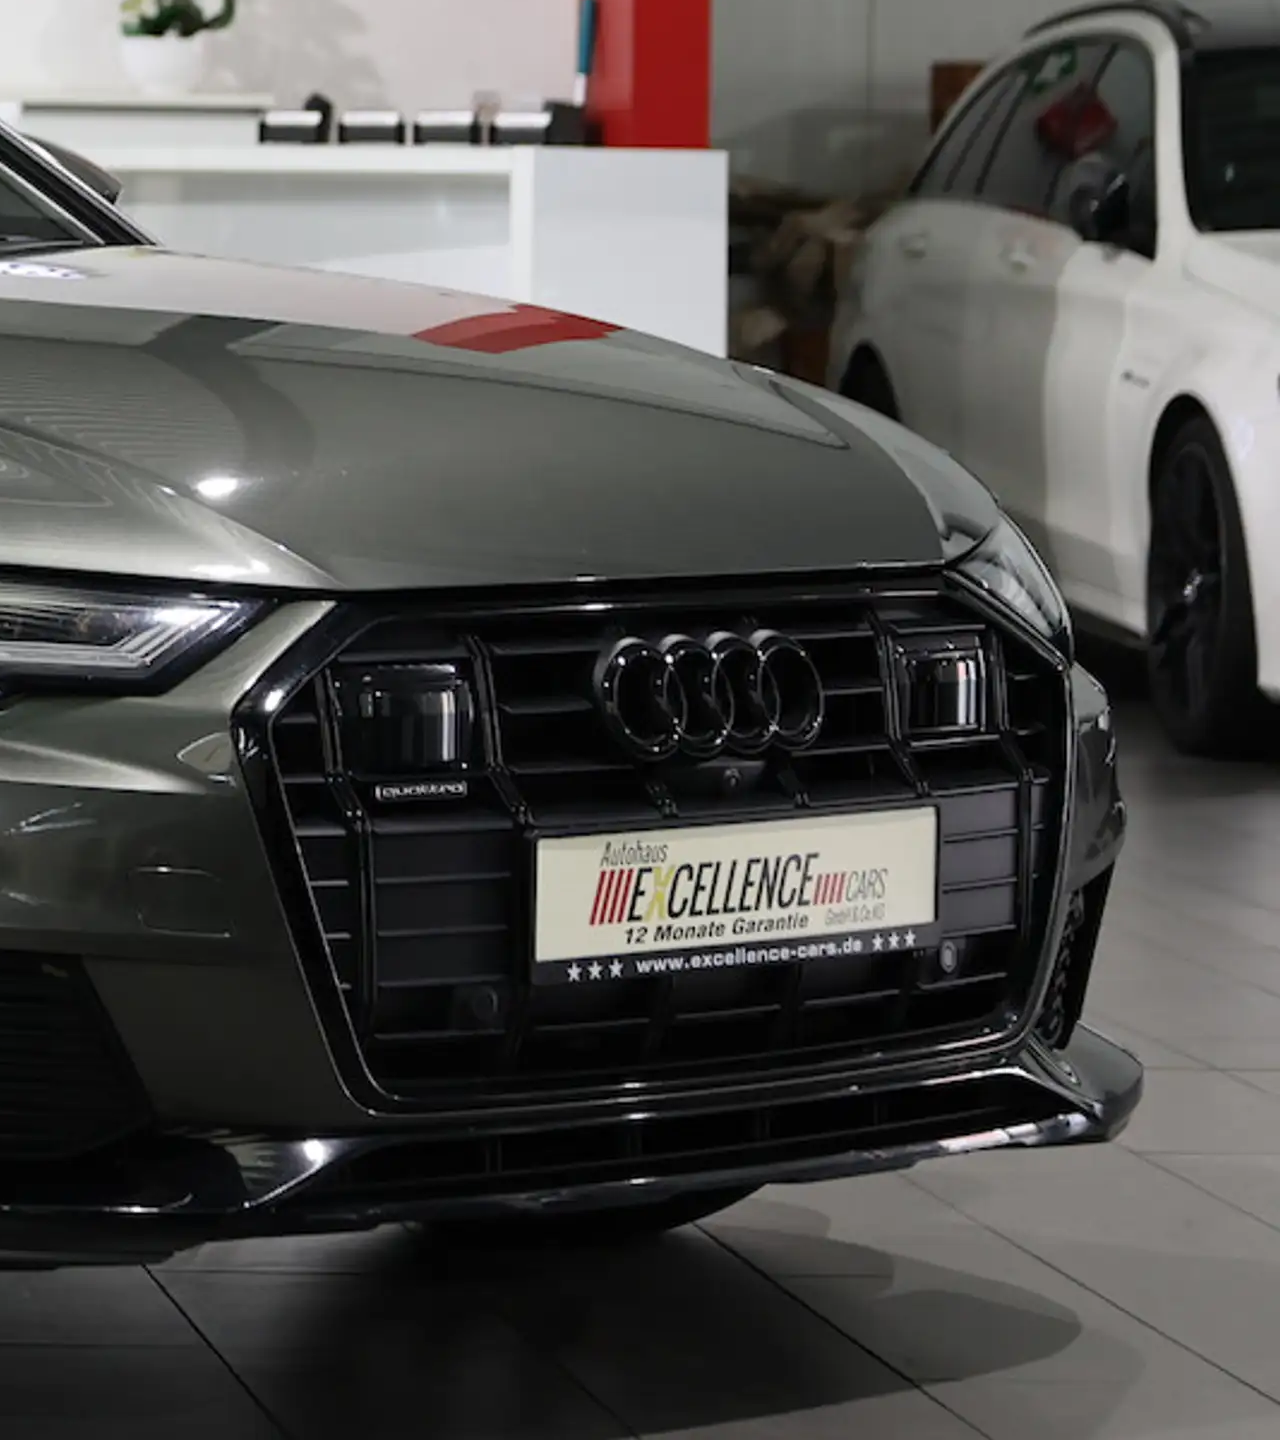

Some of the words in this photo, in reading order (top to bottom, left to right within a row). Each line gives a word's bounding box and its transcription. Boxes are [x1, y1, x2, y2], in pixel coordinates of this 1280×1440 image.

[600, 841, 668, 866] Autohaus
[627, 852, 820, 923] EXCELLENCE
[845, 868, 888, 902] CARS
[624, 927, 648, 944] 12
[653, 920, 725, 943] Monate
[732, 913, 809, 936] Garantie
[636, 938, 863, 974] www.excellence-cars.de
